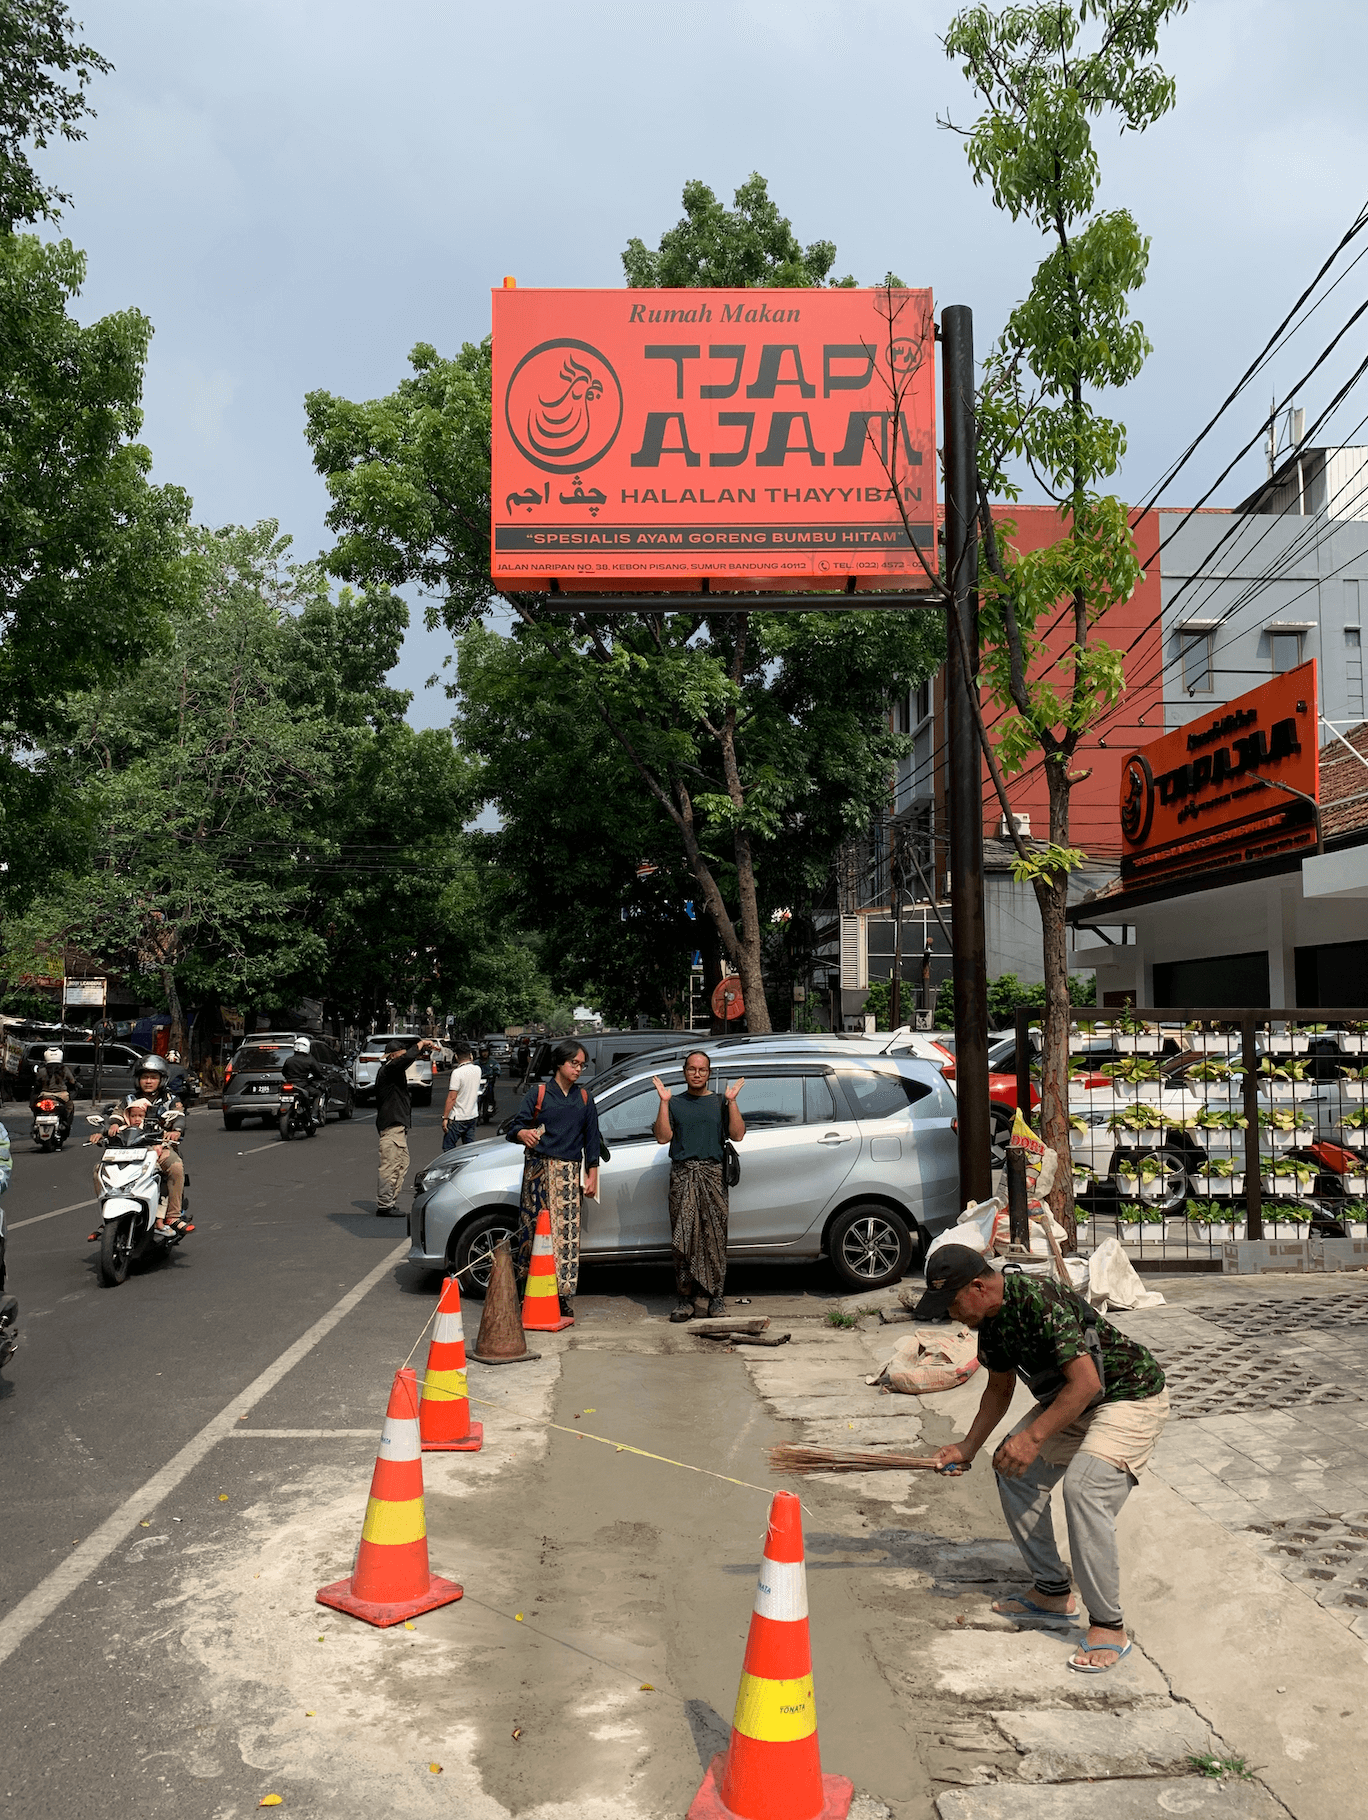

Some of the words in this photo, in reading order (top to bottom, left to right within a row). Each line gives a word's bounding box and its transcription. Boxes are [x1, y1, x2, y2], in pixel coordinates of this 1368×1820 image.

[628, 303, 713, 323] Rumah
[719, 303, 801, 323] Makan
[644, 344, 877, 399] TJAP
[630, 411, 923, 468] AJAM
[621, 488, 756, 504] HALALAN
[764, 487, 923, 503] THAYYIBAN
[636, 533, 683, 544] AYAM
[688, 532, 767, 544] GORENG
[772, 532, 837, 543] BUMBU
[856, 562, 879, 570] (022)
